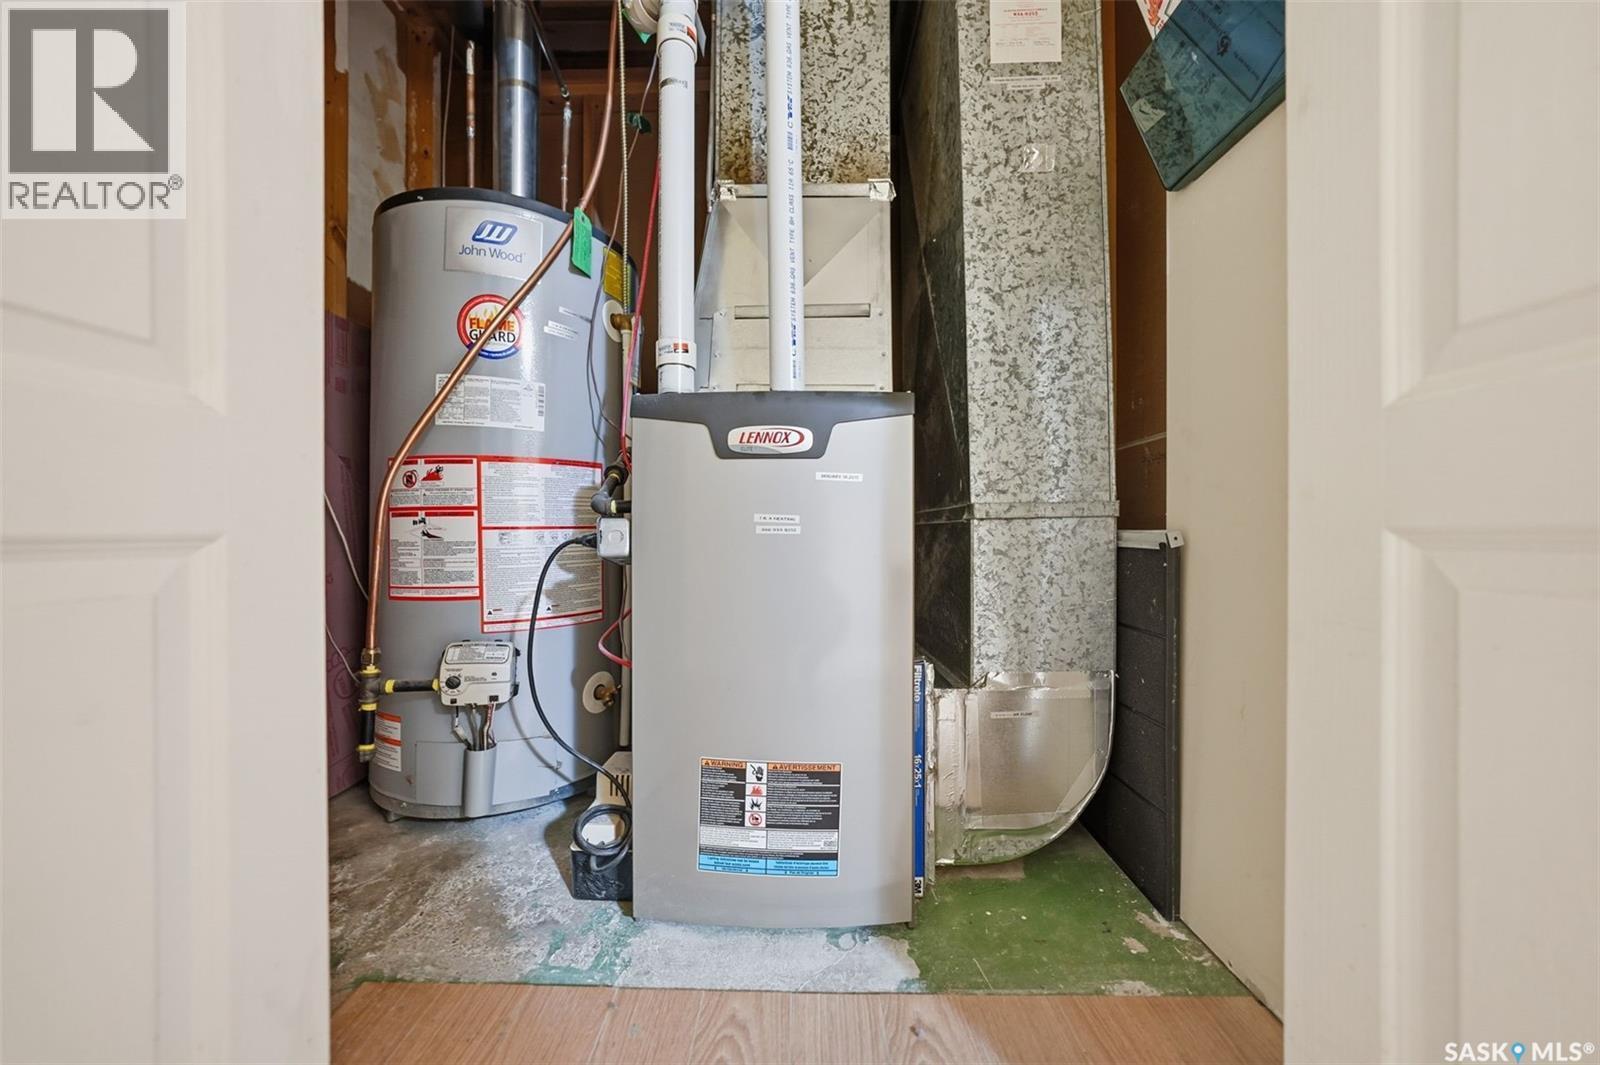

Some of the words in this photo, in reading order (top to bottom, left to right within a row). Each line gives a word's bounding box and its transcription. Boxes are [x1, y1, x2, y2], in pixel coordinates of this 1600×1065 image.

[458, 244, 487, 257] John
[488, 247, 523, 264] Wood
[739, 431, 792, 444] LENNOX
[710, 760, 744, 768] WARNING
[778, 763, 836, 771] AVERTISSEMENT
[913, 754, 923, 789] 16x25x1
